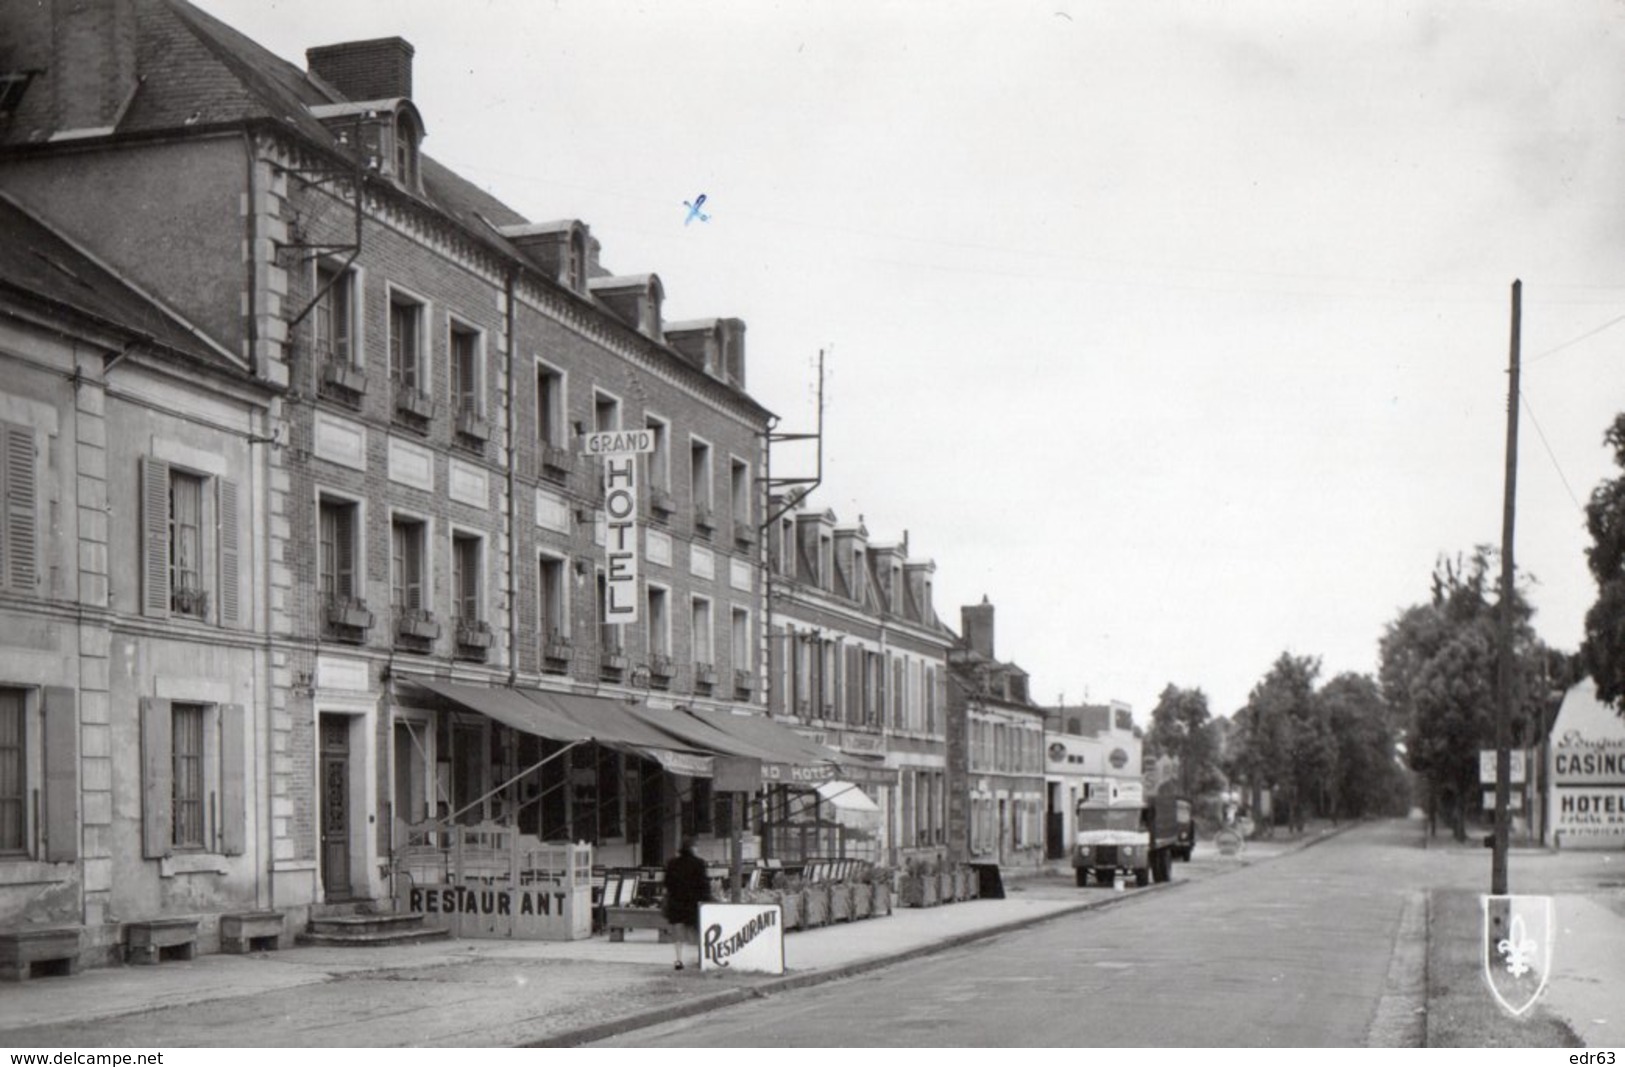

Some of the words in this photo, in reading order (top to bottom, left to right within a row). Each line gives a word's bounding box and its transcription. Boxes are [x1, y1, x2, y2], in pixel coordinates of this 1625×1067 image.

[589, 432, 650, 452] GRAND
[606, 458, 634, 614] HOTEL
[410, 886, 566, 916] RESTAURANT
